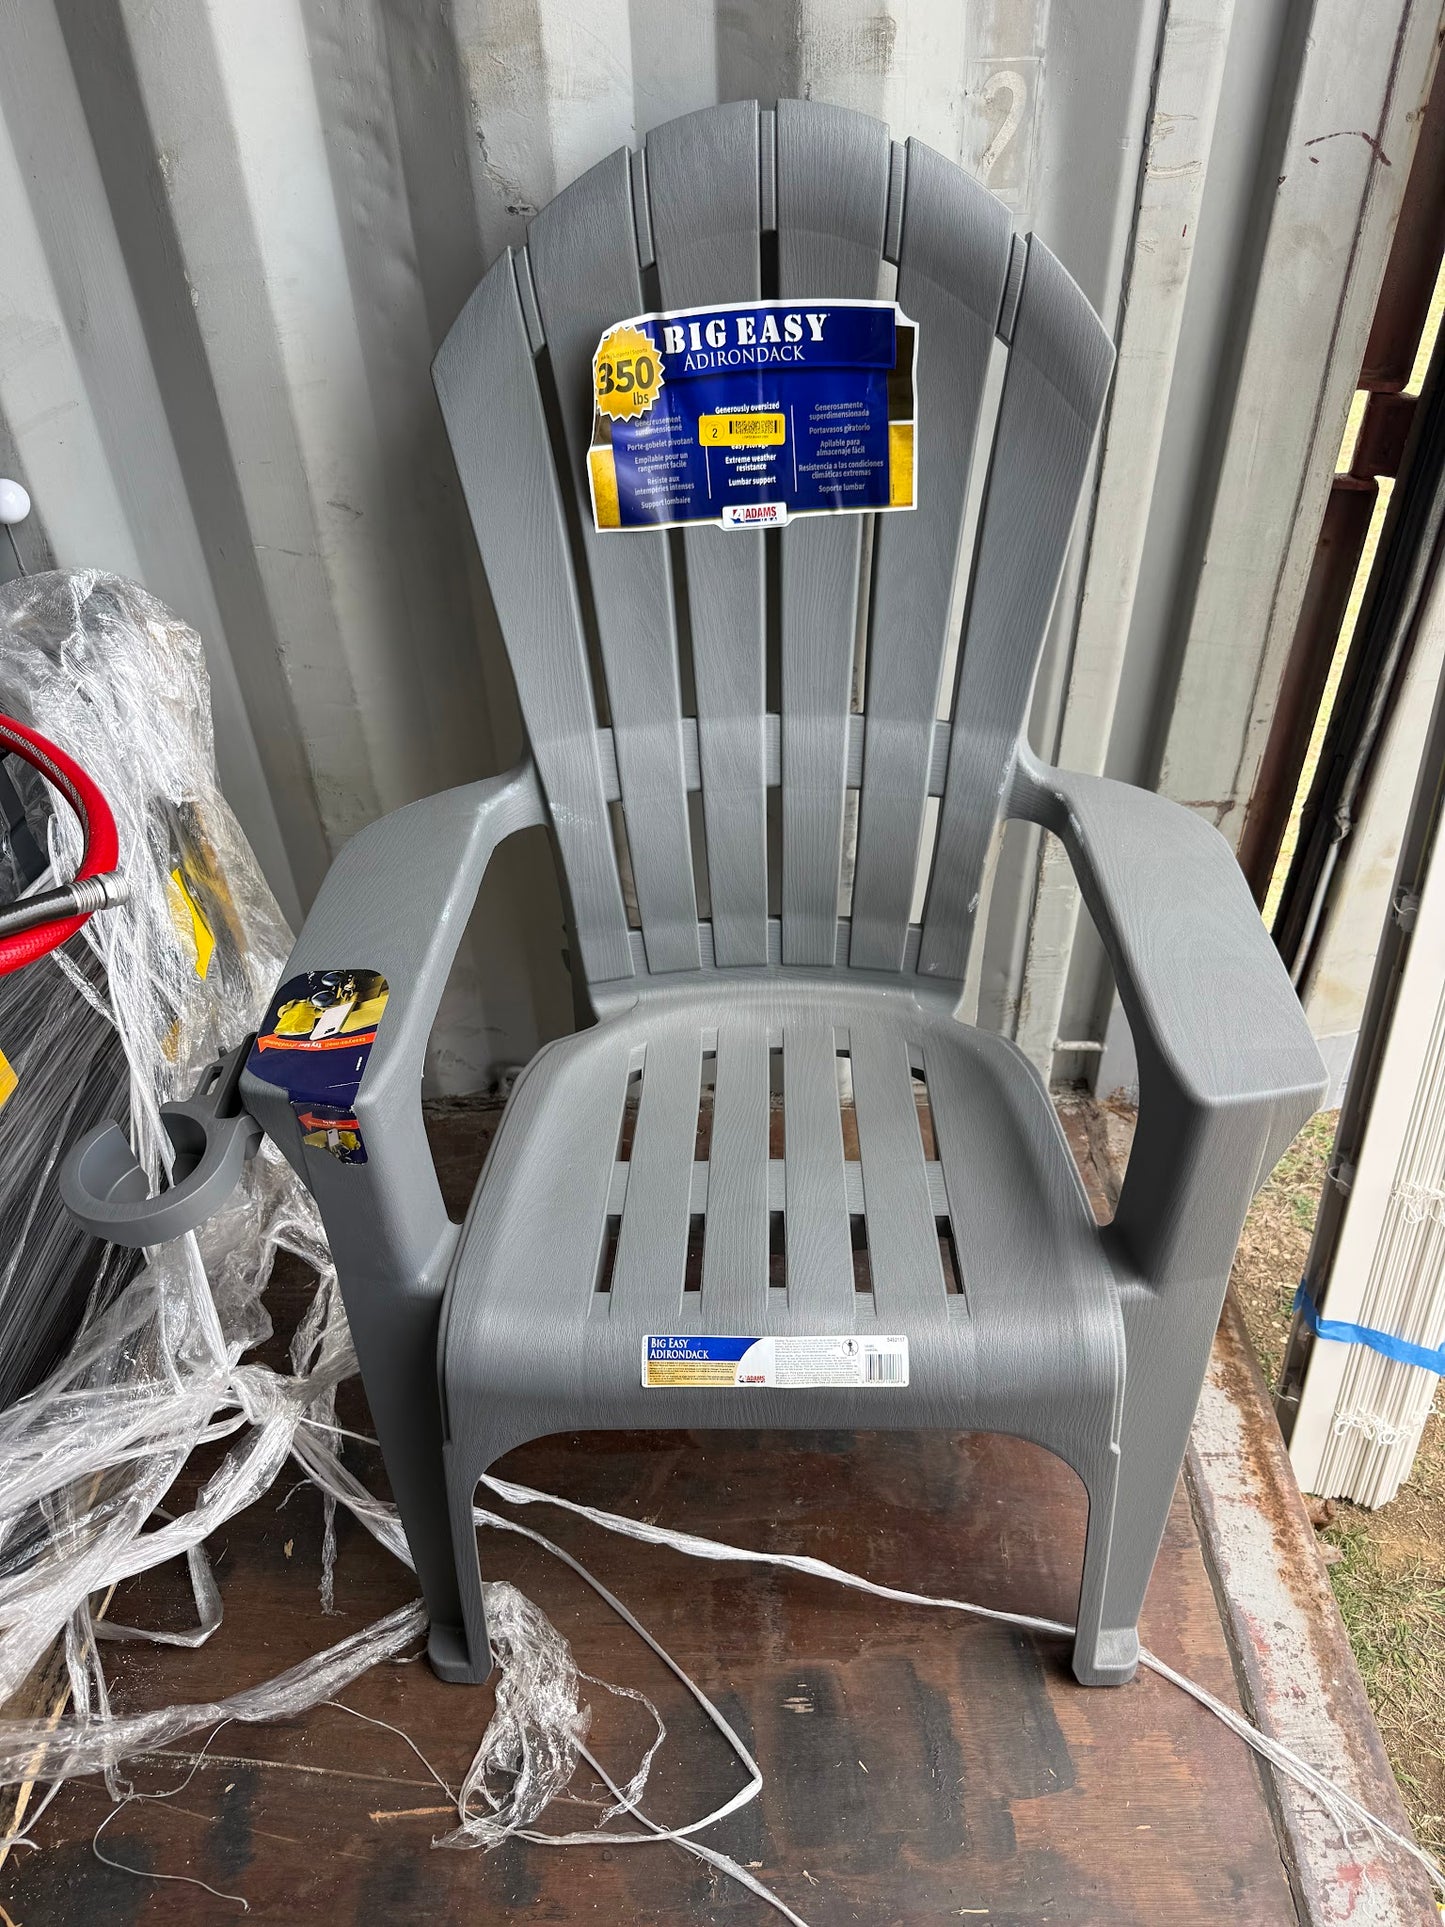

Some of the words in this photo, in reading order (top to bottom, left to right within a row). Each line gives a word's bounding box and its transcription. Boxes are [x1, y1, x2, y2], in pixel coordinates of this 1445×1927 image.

[663, 319, 727, 354] BIG
[736, 314, 827, 345] EASY
[684, 345, 806, 372] ADIRONDACK
[599, 356, 654, 395] 350
[634, 392, 649, 406] lbs
[715, 404, 750, 414] Generously
[751, 401, 780, 411] oversized
[814, 402, 863, 411] Generosamente
[809, 409, 869, 421] superdimensionada
[712, 428, 718, 438] 2
[809, 426, 843, 434] Portavasos
[844, 423, 870, 434] giratorio
[627, 441, 667, 452] Porte-gobelet
[668, 438, 694, 447] pivotant
[820, 439, 845, 449] Apilable
[846, 439, 860, 448] para
[816, 448, 851, 456] almacenaje
[634, 454, 664, 464] Empilable
[725, 456, 750, 464] Extreme
[752, 453, 776, 462] weather
[638, 462, 669, 473] rangement
[736, 463, 767, 472] resistance
[798, 462, 832, 472] Resistencia
[848, 460, 884, 468] condiciones
[812, 470, 842, 479] climáticas
[648, 477, 667, 485] Résiste
[728, 478, 751, 486] Lumbar
[752, 476, 776, 485] support
[634, 485, 669, 496] intempéries
[818, 485, 842, 493] Soporte
[641, 499, 664, 509] Support
[665, 496, 691, 505] lombaire
[745, 506, 776, 518] ADAMS
[651, 1338, 666, 1348] BIG
[668, 1338, 689, 1348] EASY
[650, 1349, 709, 1359] ADIRONDACK
